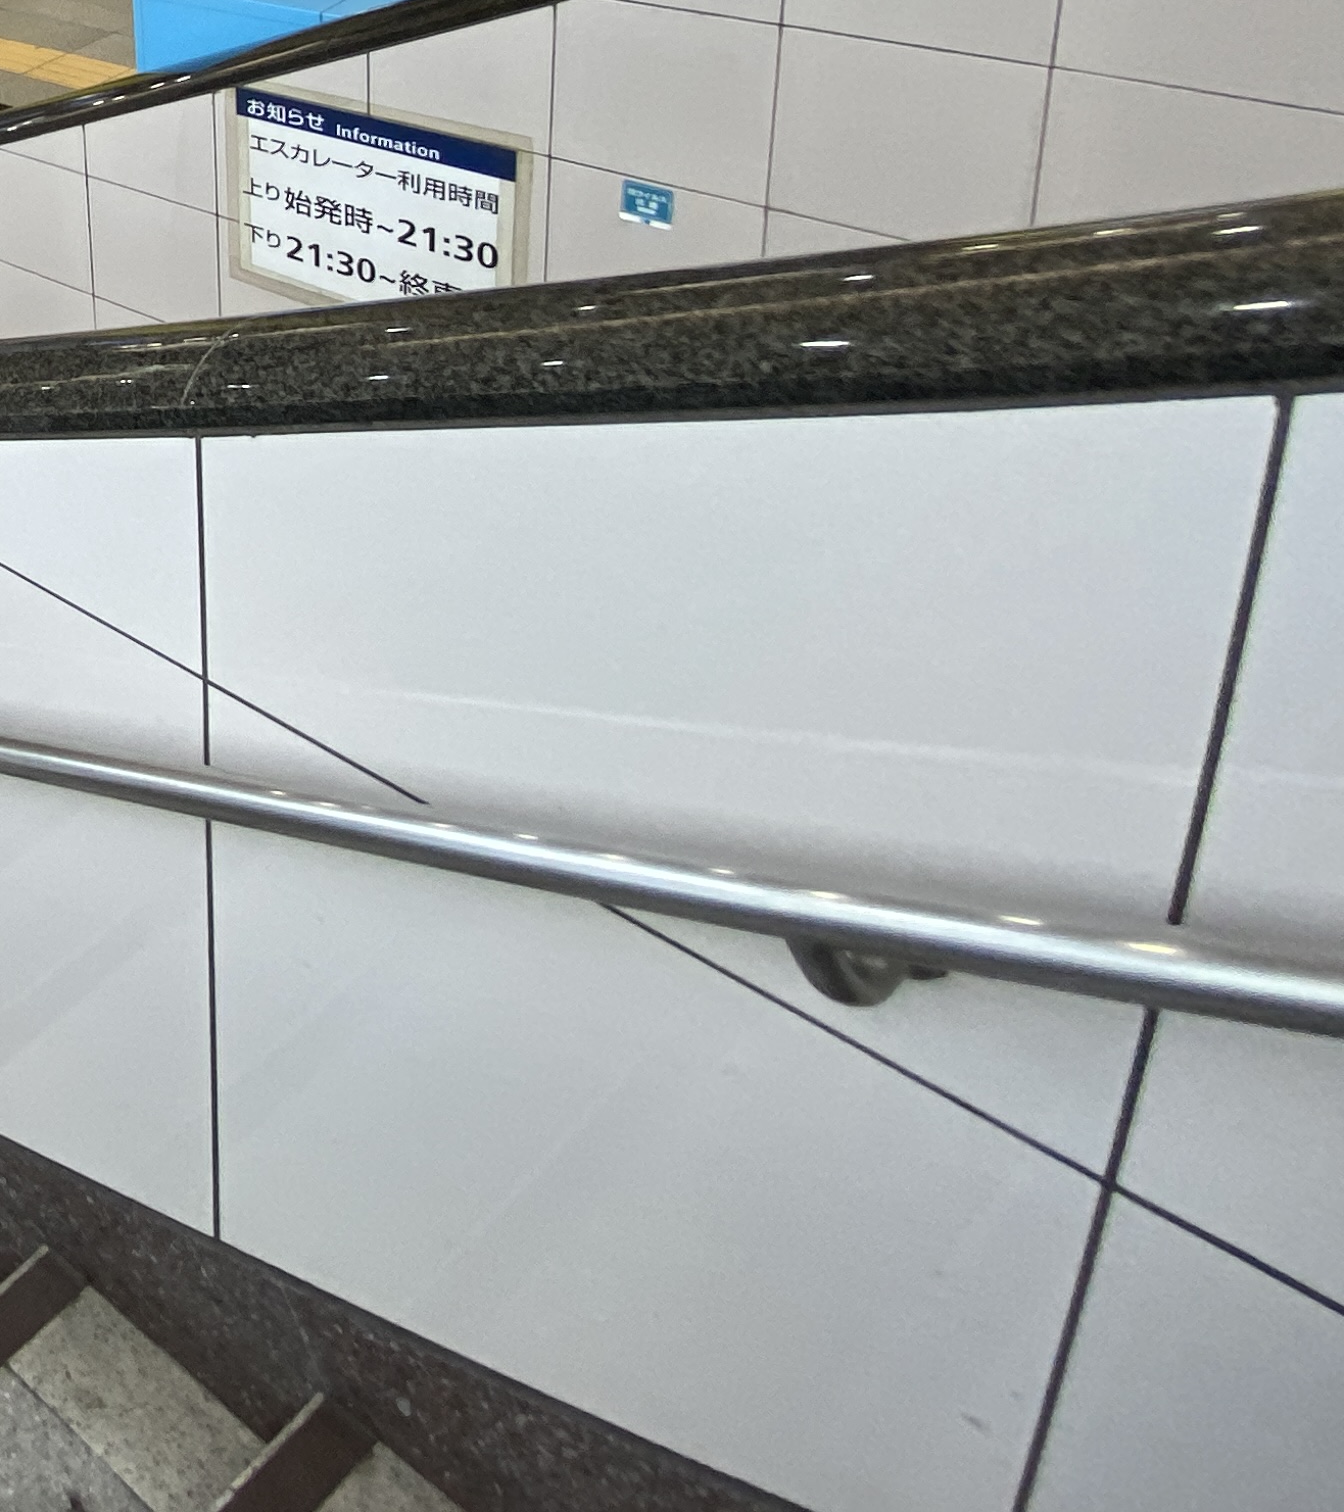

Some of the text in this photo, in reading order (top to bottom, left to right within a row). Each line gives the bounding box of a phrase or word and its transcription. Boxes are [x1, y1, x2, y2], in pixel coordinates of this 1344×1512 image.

[247, 99, 440, 161] お知らせ Information
[250, 134, 499, 215] エスカレーター利用時間
